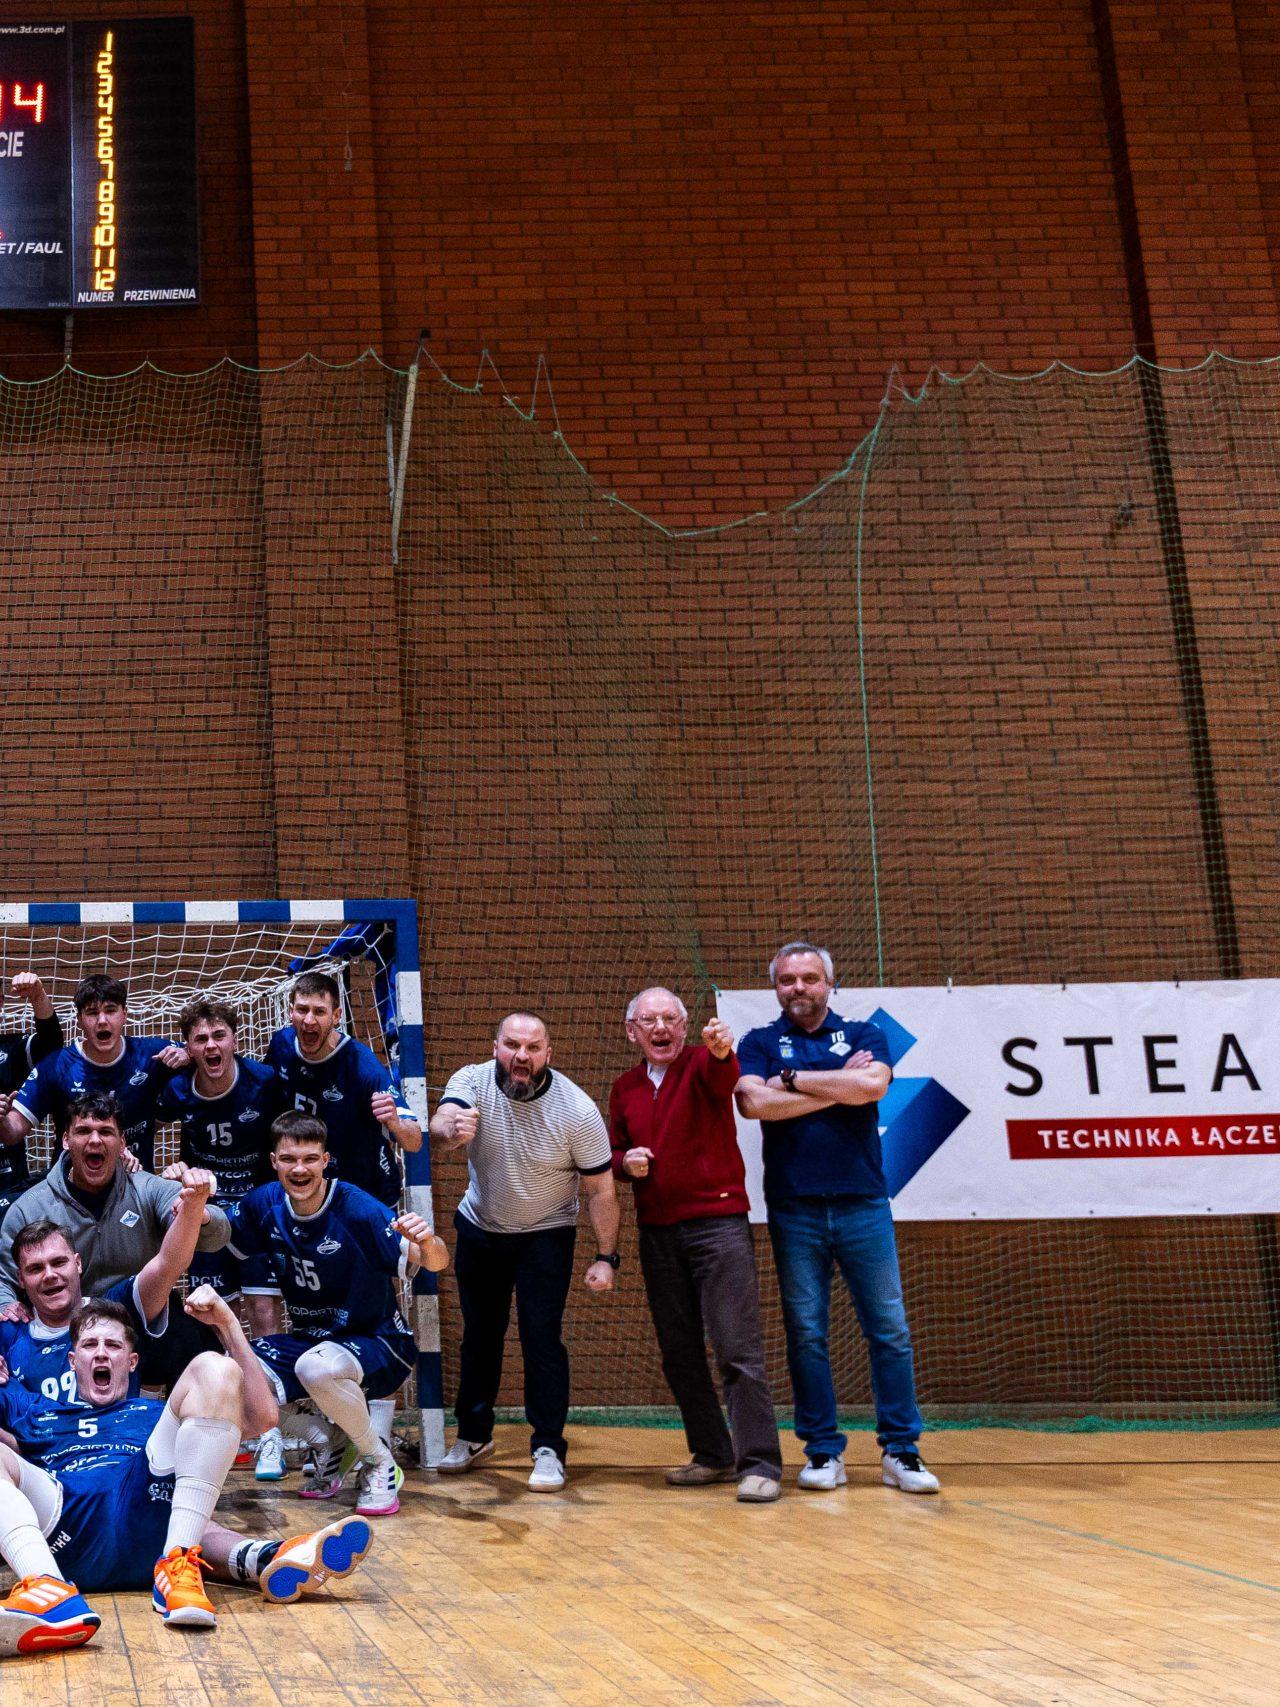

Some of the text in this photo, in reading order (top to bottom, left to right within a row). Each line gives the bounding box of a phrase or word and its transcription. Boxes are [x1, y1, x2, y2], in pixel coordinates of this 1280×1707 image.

[105, 32, 113, 52] 1
[97, 52, 113, 73] 2
[97, 74, 113, 95] 3
[98, 95, 113, 114] 4
[98, 116, 113, 137] 5
[98, 138, 113, 159] 6
[99, 159, 114, 179] 7
[99, 181, 114, 202] 8
[99, 202, 114, 224] 9
[94, 225, 115, 247] 10
[94, 248, 115, 268] 11
[94, 269, 115, 291] 12
[77, 288, 197, 303] NUMER PRZEWINIENIA
[206, 1122, 233, 1147] 15
[1037, 1124, 1280, 1150] TECHNIKA ŁĄCZE
[291, 1255, 321, 1291] 55
[77, 1418, 99, 1438] 5
